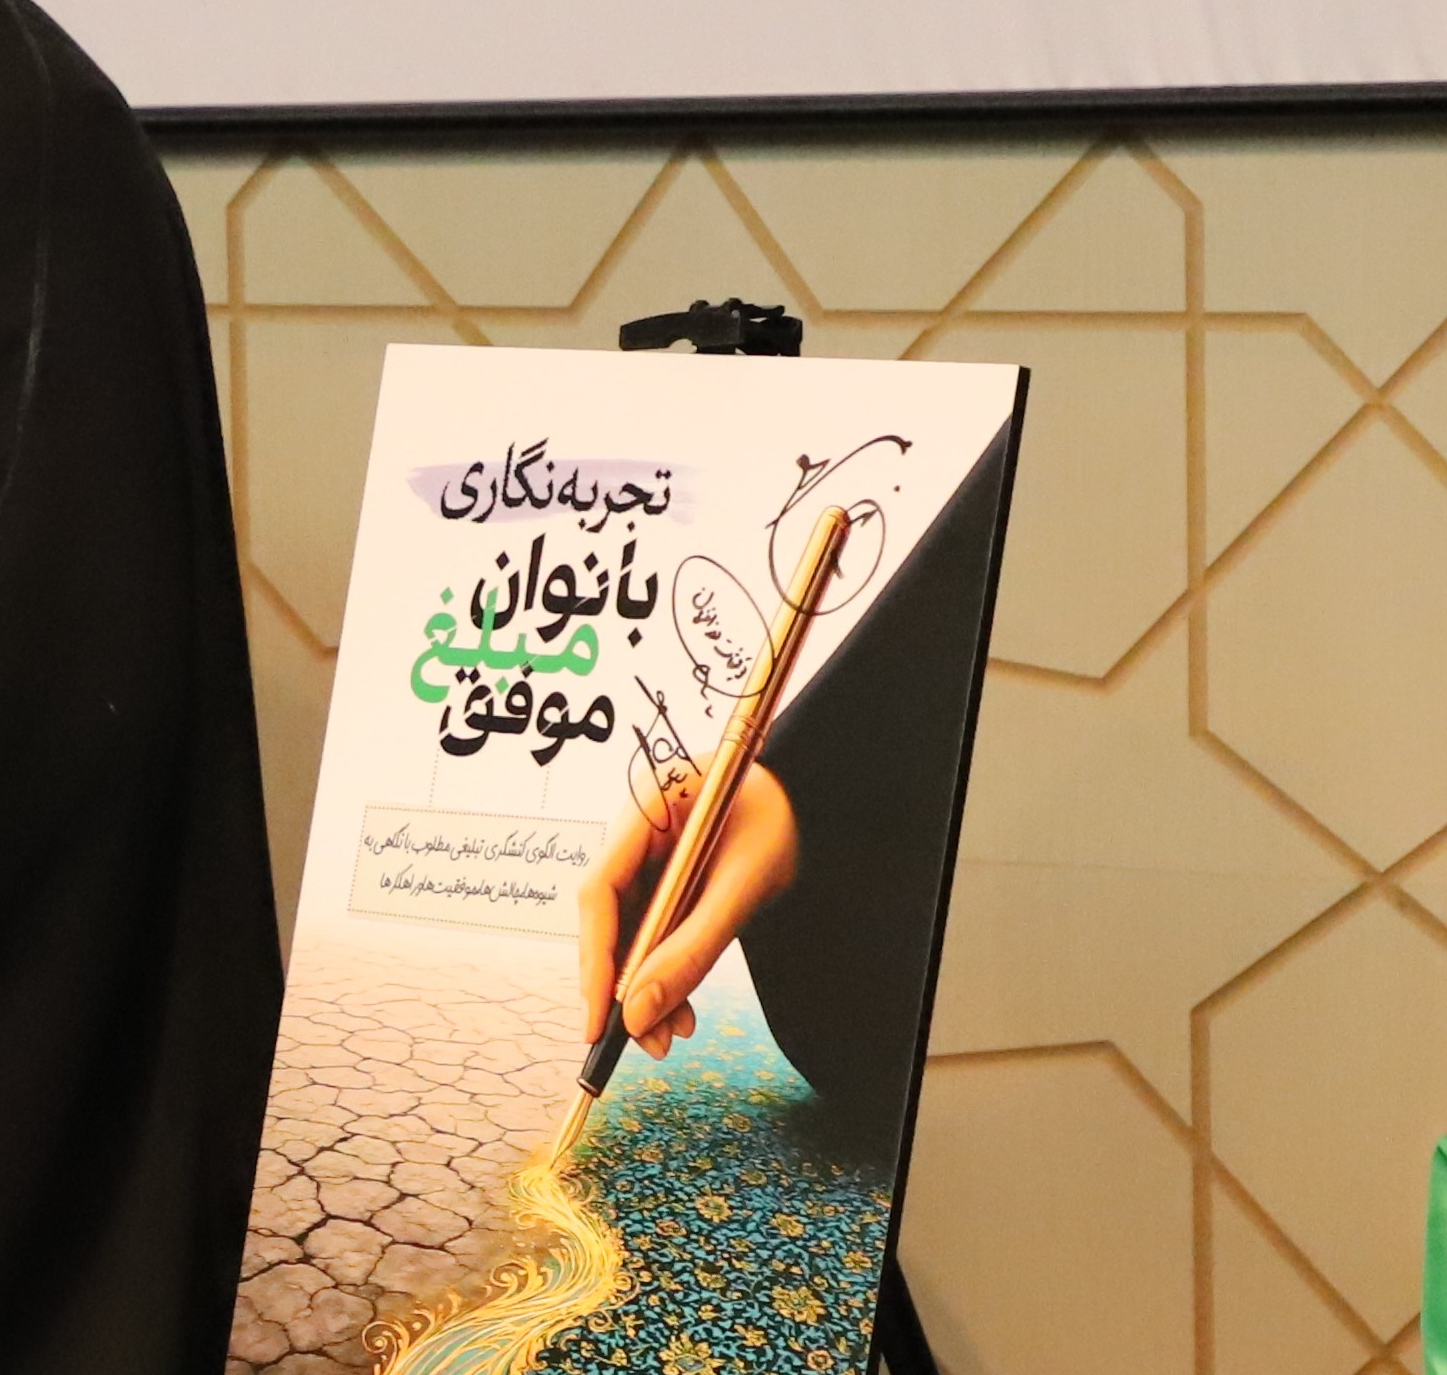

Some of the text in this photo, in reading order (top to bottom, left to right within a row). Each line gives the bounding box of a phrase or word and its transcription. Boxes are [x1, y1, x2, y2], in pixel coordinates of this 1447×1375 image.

[470, 532, 659, 648] بانوان
[410, 586, 599, 704] مبلغ
[439, 661, 615, 767] موفق
[364, 834, 374, 852] به
[404, 832, 412, 854] با
[411, 835, 451, 857] مطلوب
[450, 836, 485, 861] تبلیغی
[556, 844, 590, 867] روایت
